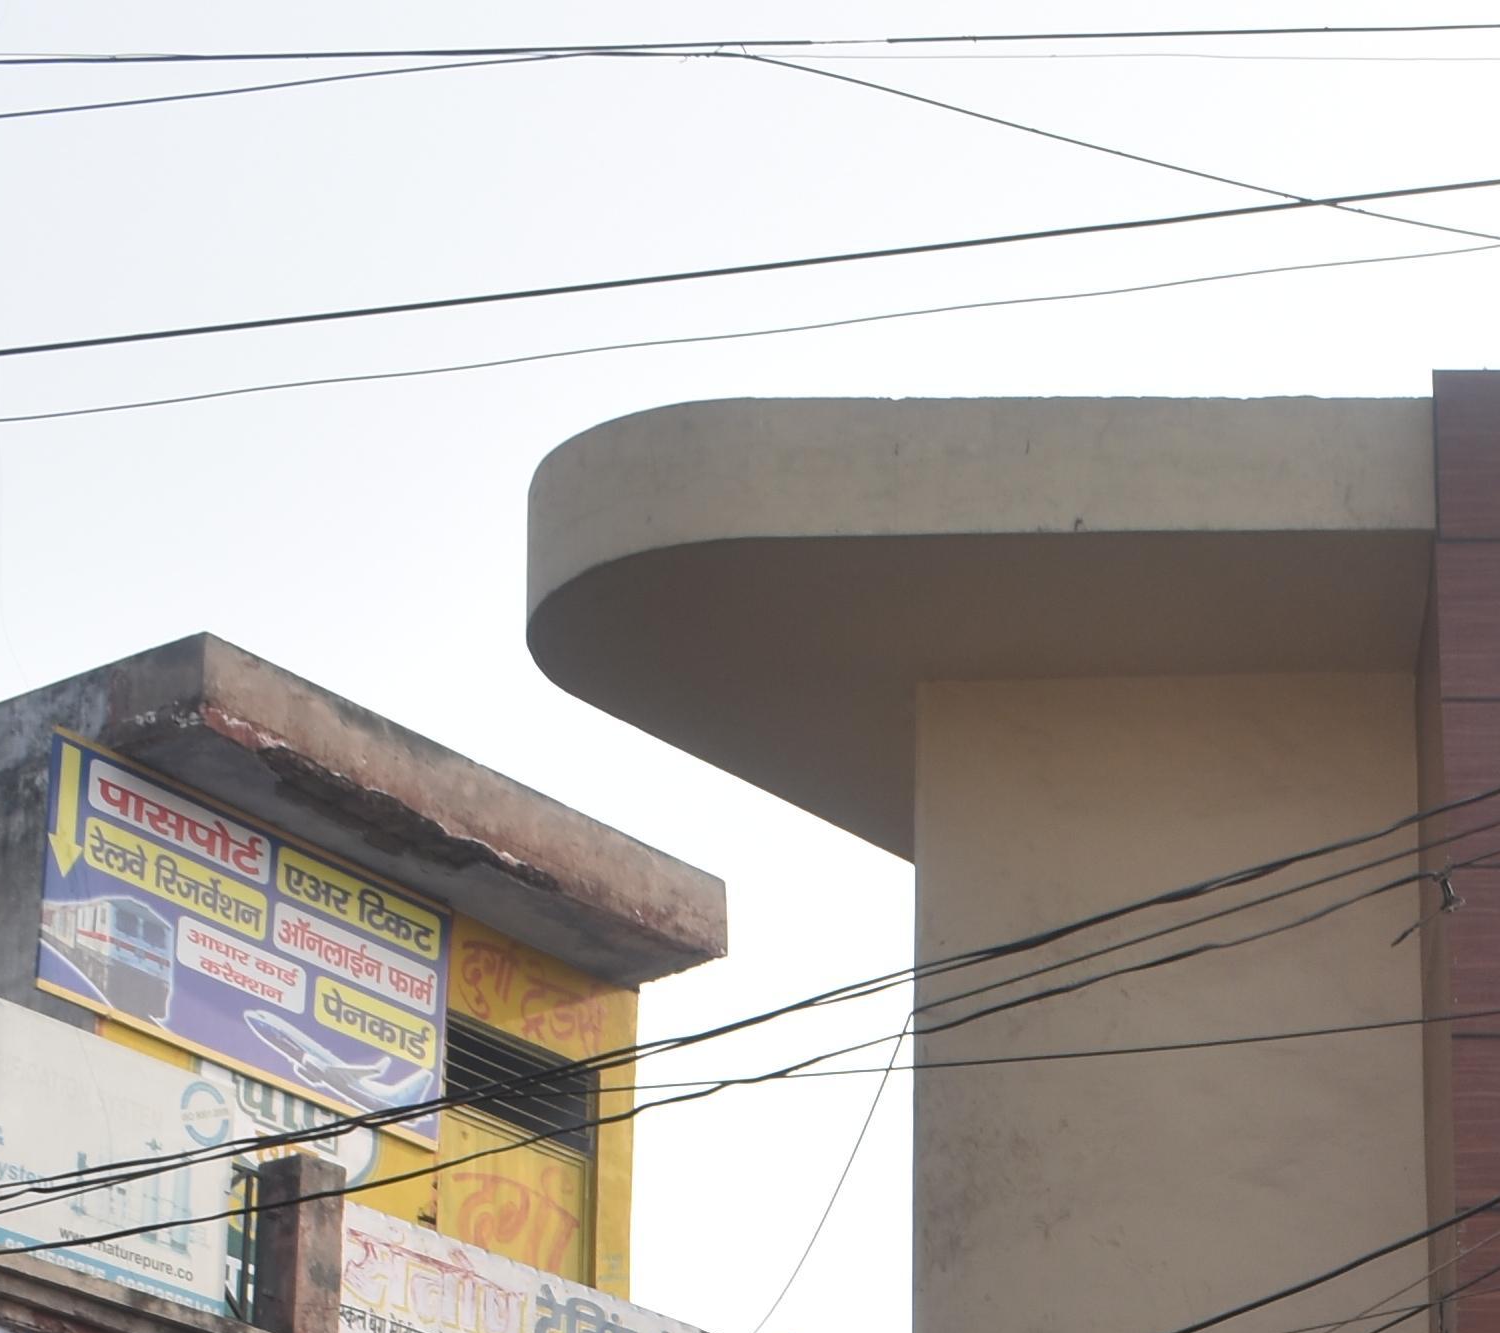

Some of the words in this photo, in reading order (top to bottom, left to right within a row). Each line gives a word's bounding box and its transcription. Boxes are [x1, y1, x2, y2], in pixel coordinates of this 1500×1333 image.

[97, 776, 264, 878] पासपोर्ट
[154, 854, 261, 934] रिजर्वेशन
[284, 862, 351, 915] एअर
[356, 888, 434, 952] टिकट
[255, 955, 299, 987] कार्ड
[278, 917, 382, 985] ऑनलाईन
[387, 965, 434, 1006] फार्म
[322, 988, 434, 1062] पेनकार्ड
